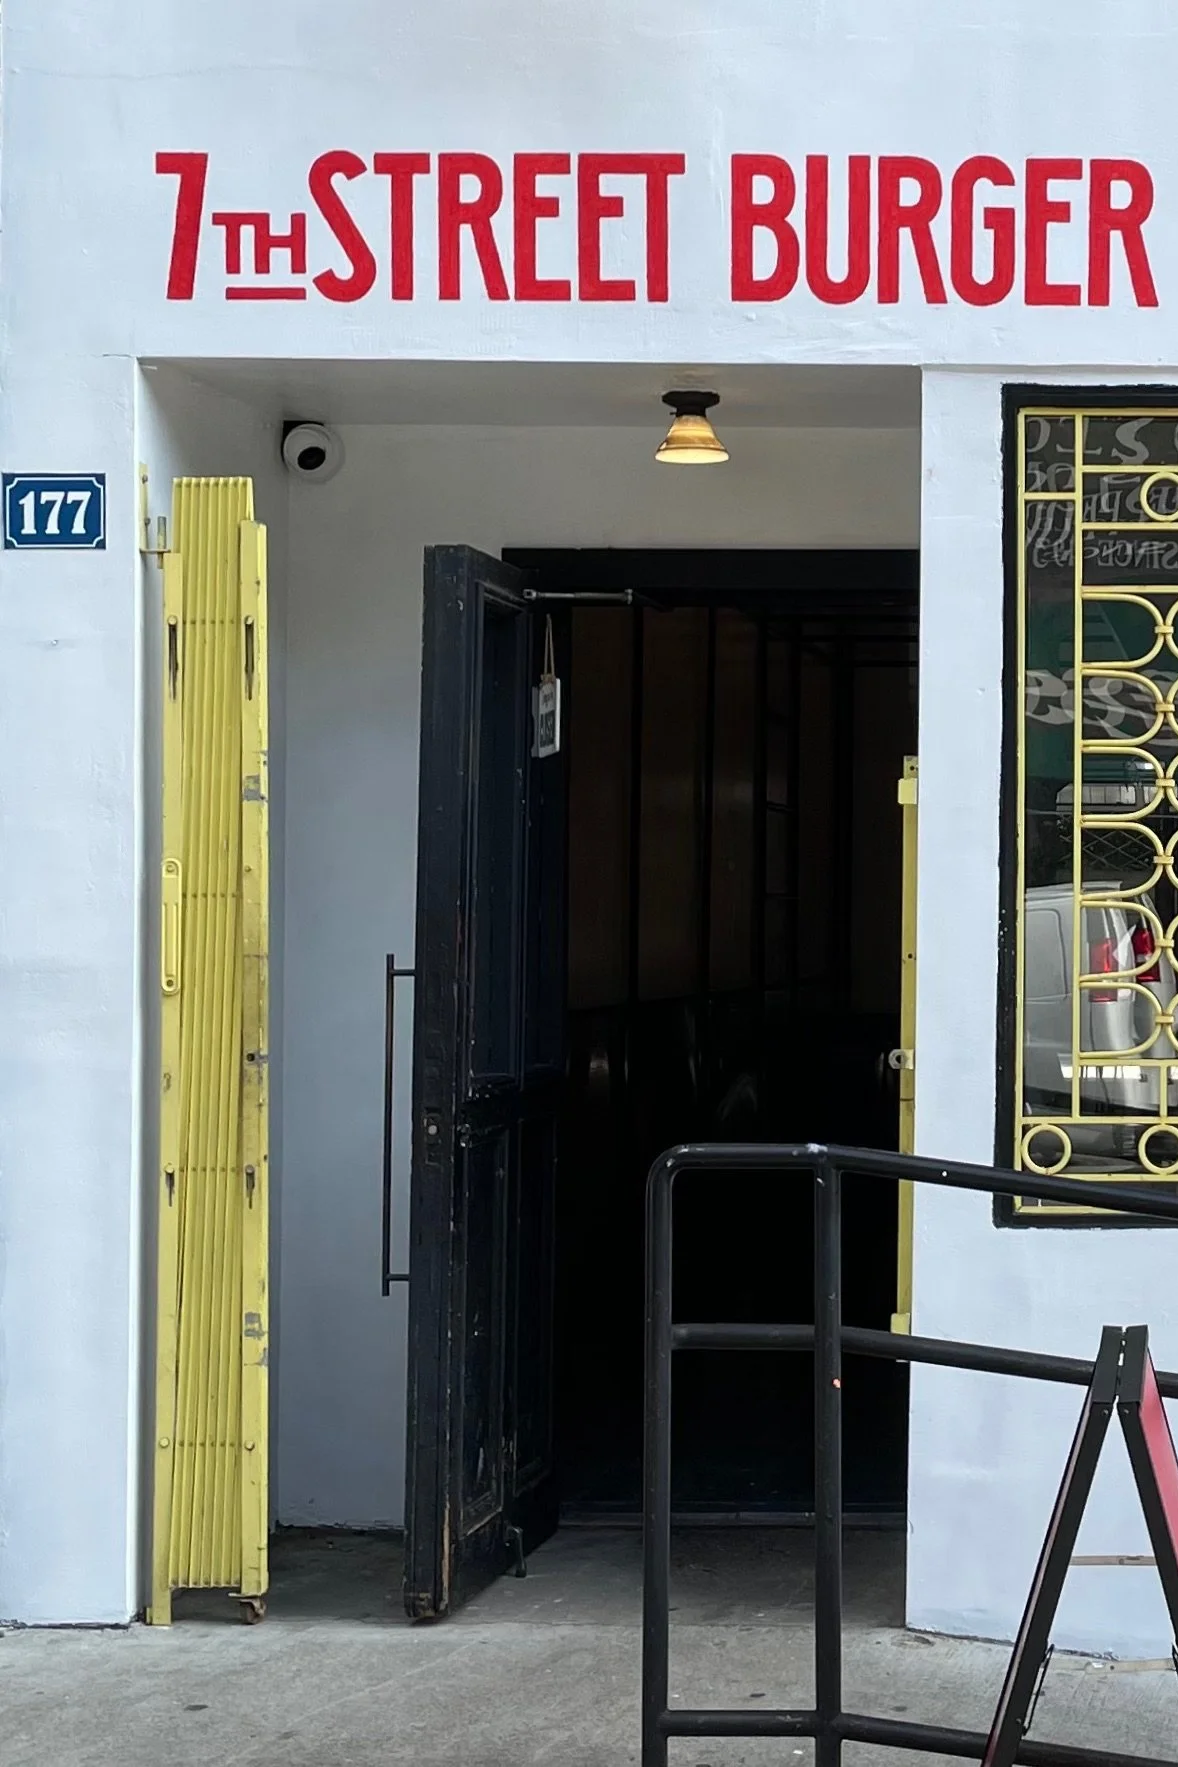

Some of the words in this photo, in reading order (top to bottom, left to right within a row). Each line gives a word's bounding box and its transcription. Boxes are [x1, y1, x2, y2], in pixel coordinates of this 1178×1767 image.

[308, 150, 685, 303] STREET
[731, 155, 1160, 309] BURGER
[18, 490, 92, 535] 177
